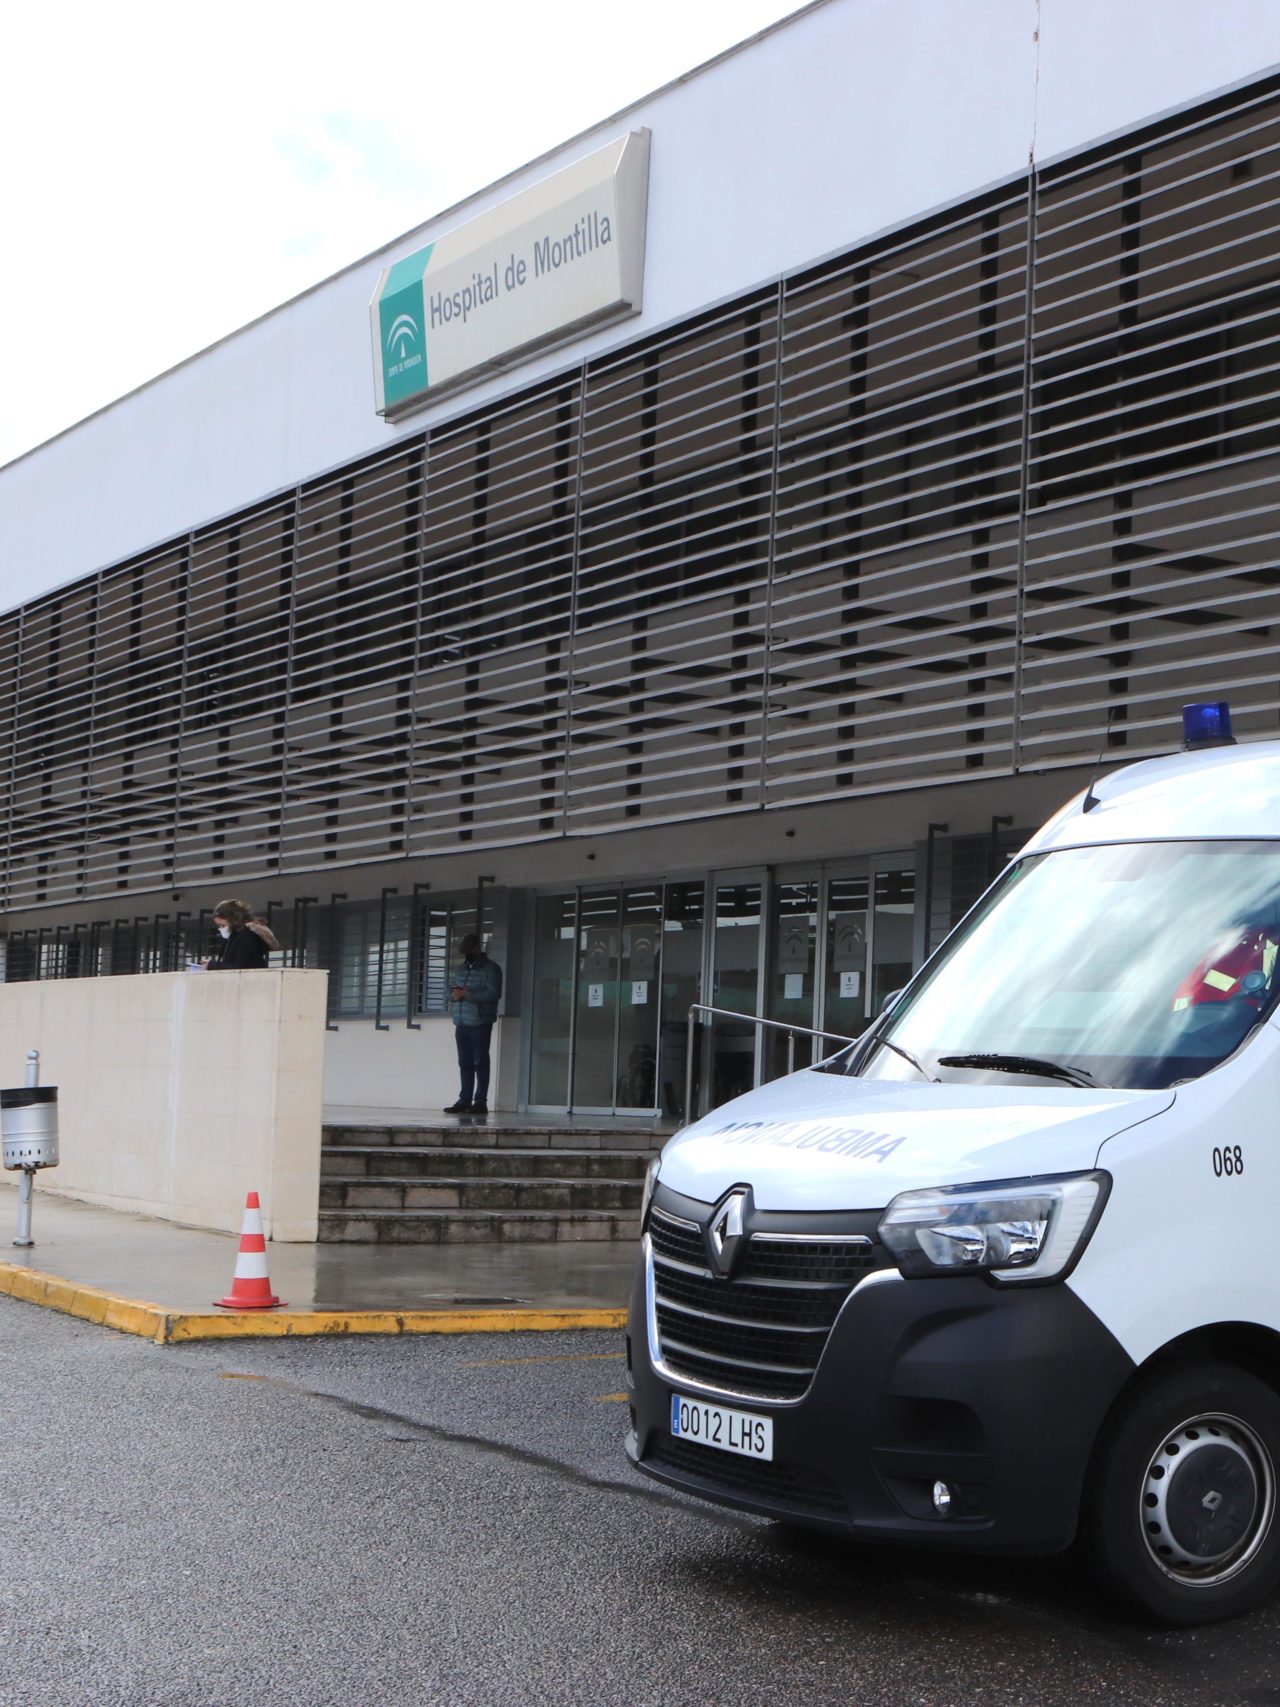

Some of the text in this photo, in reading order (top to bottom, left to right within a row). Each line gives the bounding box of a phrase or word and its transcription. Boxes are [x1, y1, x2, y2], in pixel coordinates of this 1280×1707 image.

[430, 211, 612, 329] Hospital de Montilla
[1212, 1144, 1244, 1178] 068
[681, 1402, 722, 1444] 0012
[729, 1415, 765, 1453] LHS
